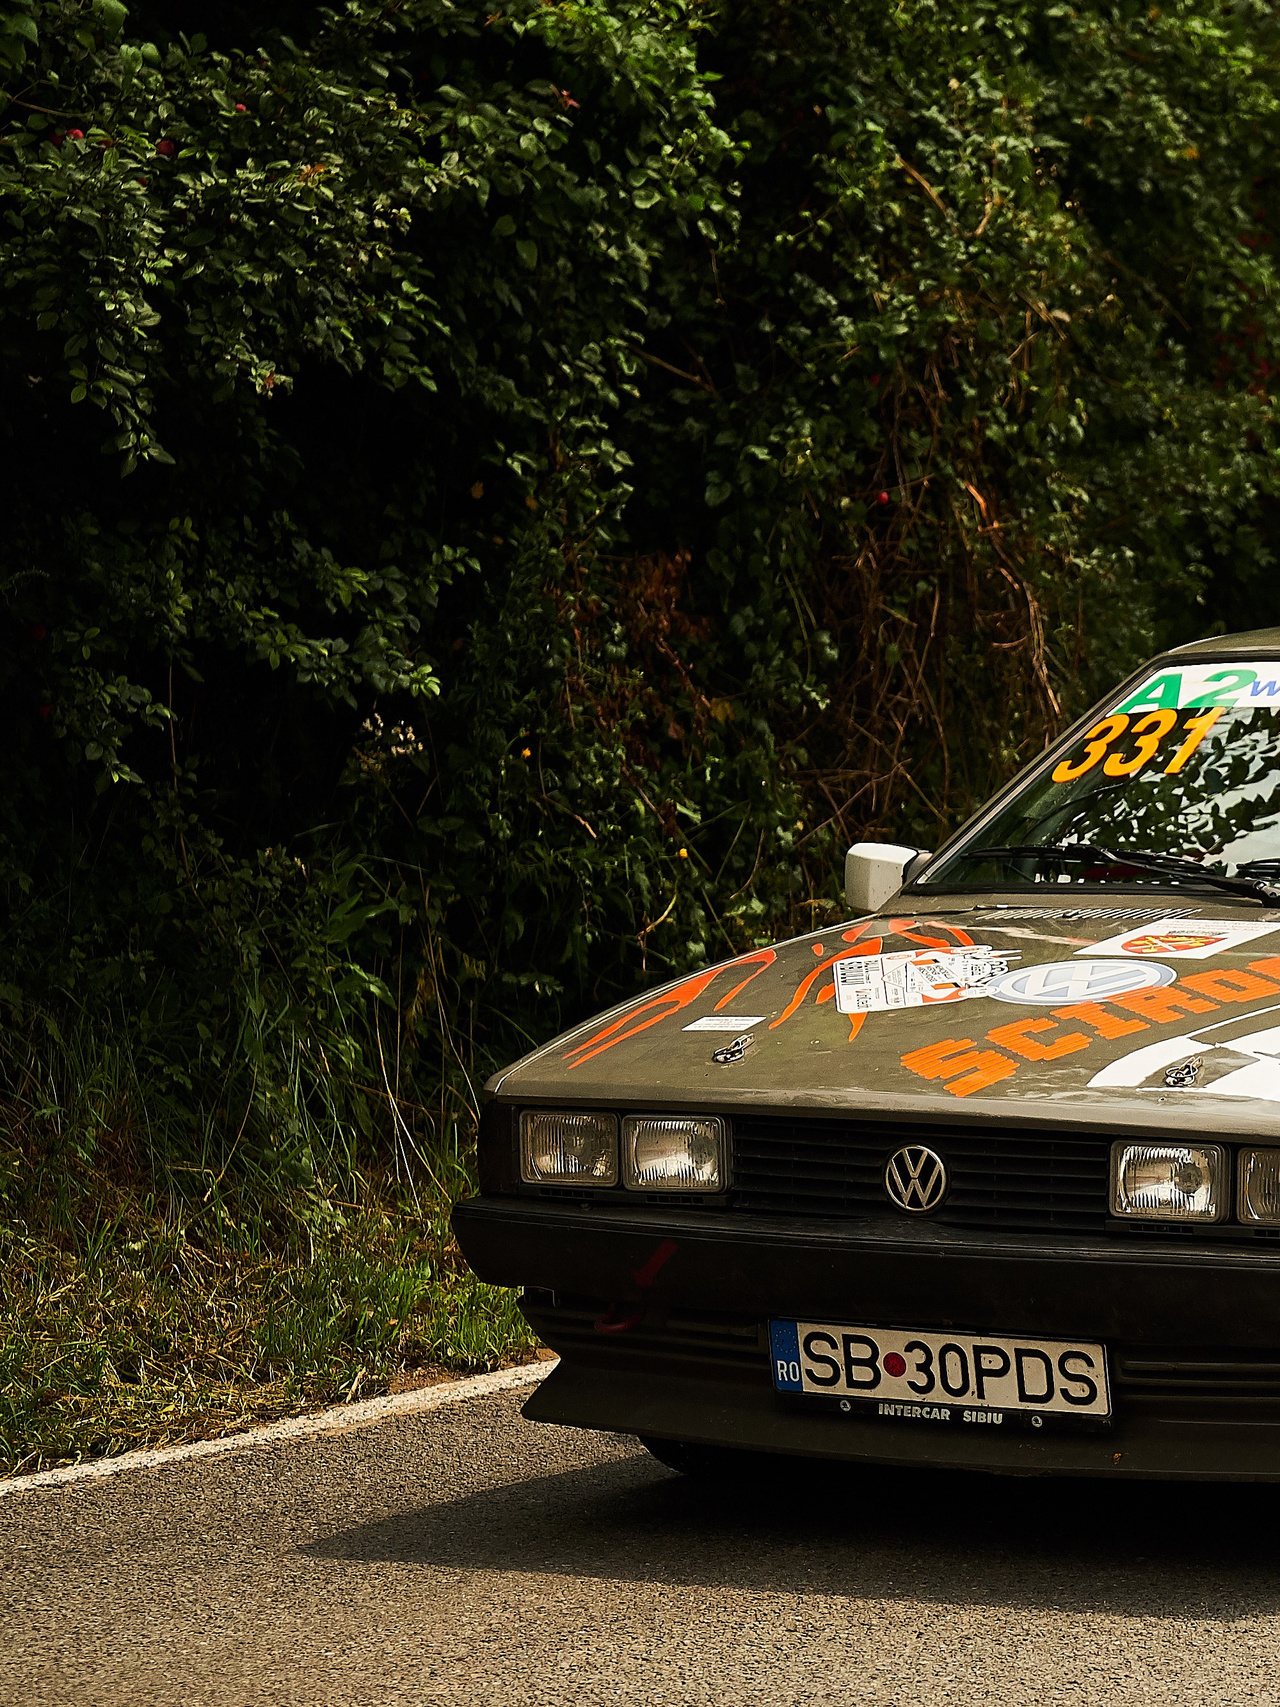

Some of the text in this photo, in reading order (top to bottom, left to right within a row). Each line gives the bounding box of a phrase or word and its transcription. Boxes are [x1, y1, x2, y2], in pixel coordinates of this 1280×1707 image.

[1051, 707, 1226, 783] 331
[777, 1360, 799, 1383] RO
[802, 1331, 882, 1391] SB
[878, 1403, 1003, 1425] INTERCAR SIBIU
